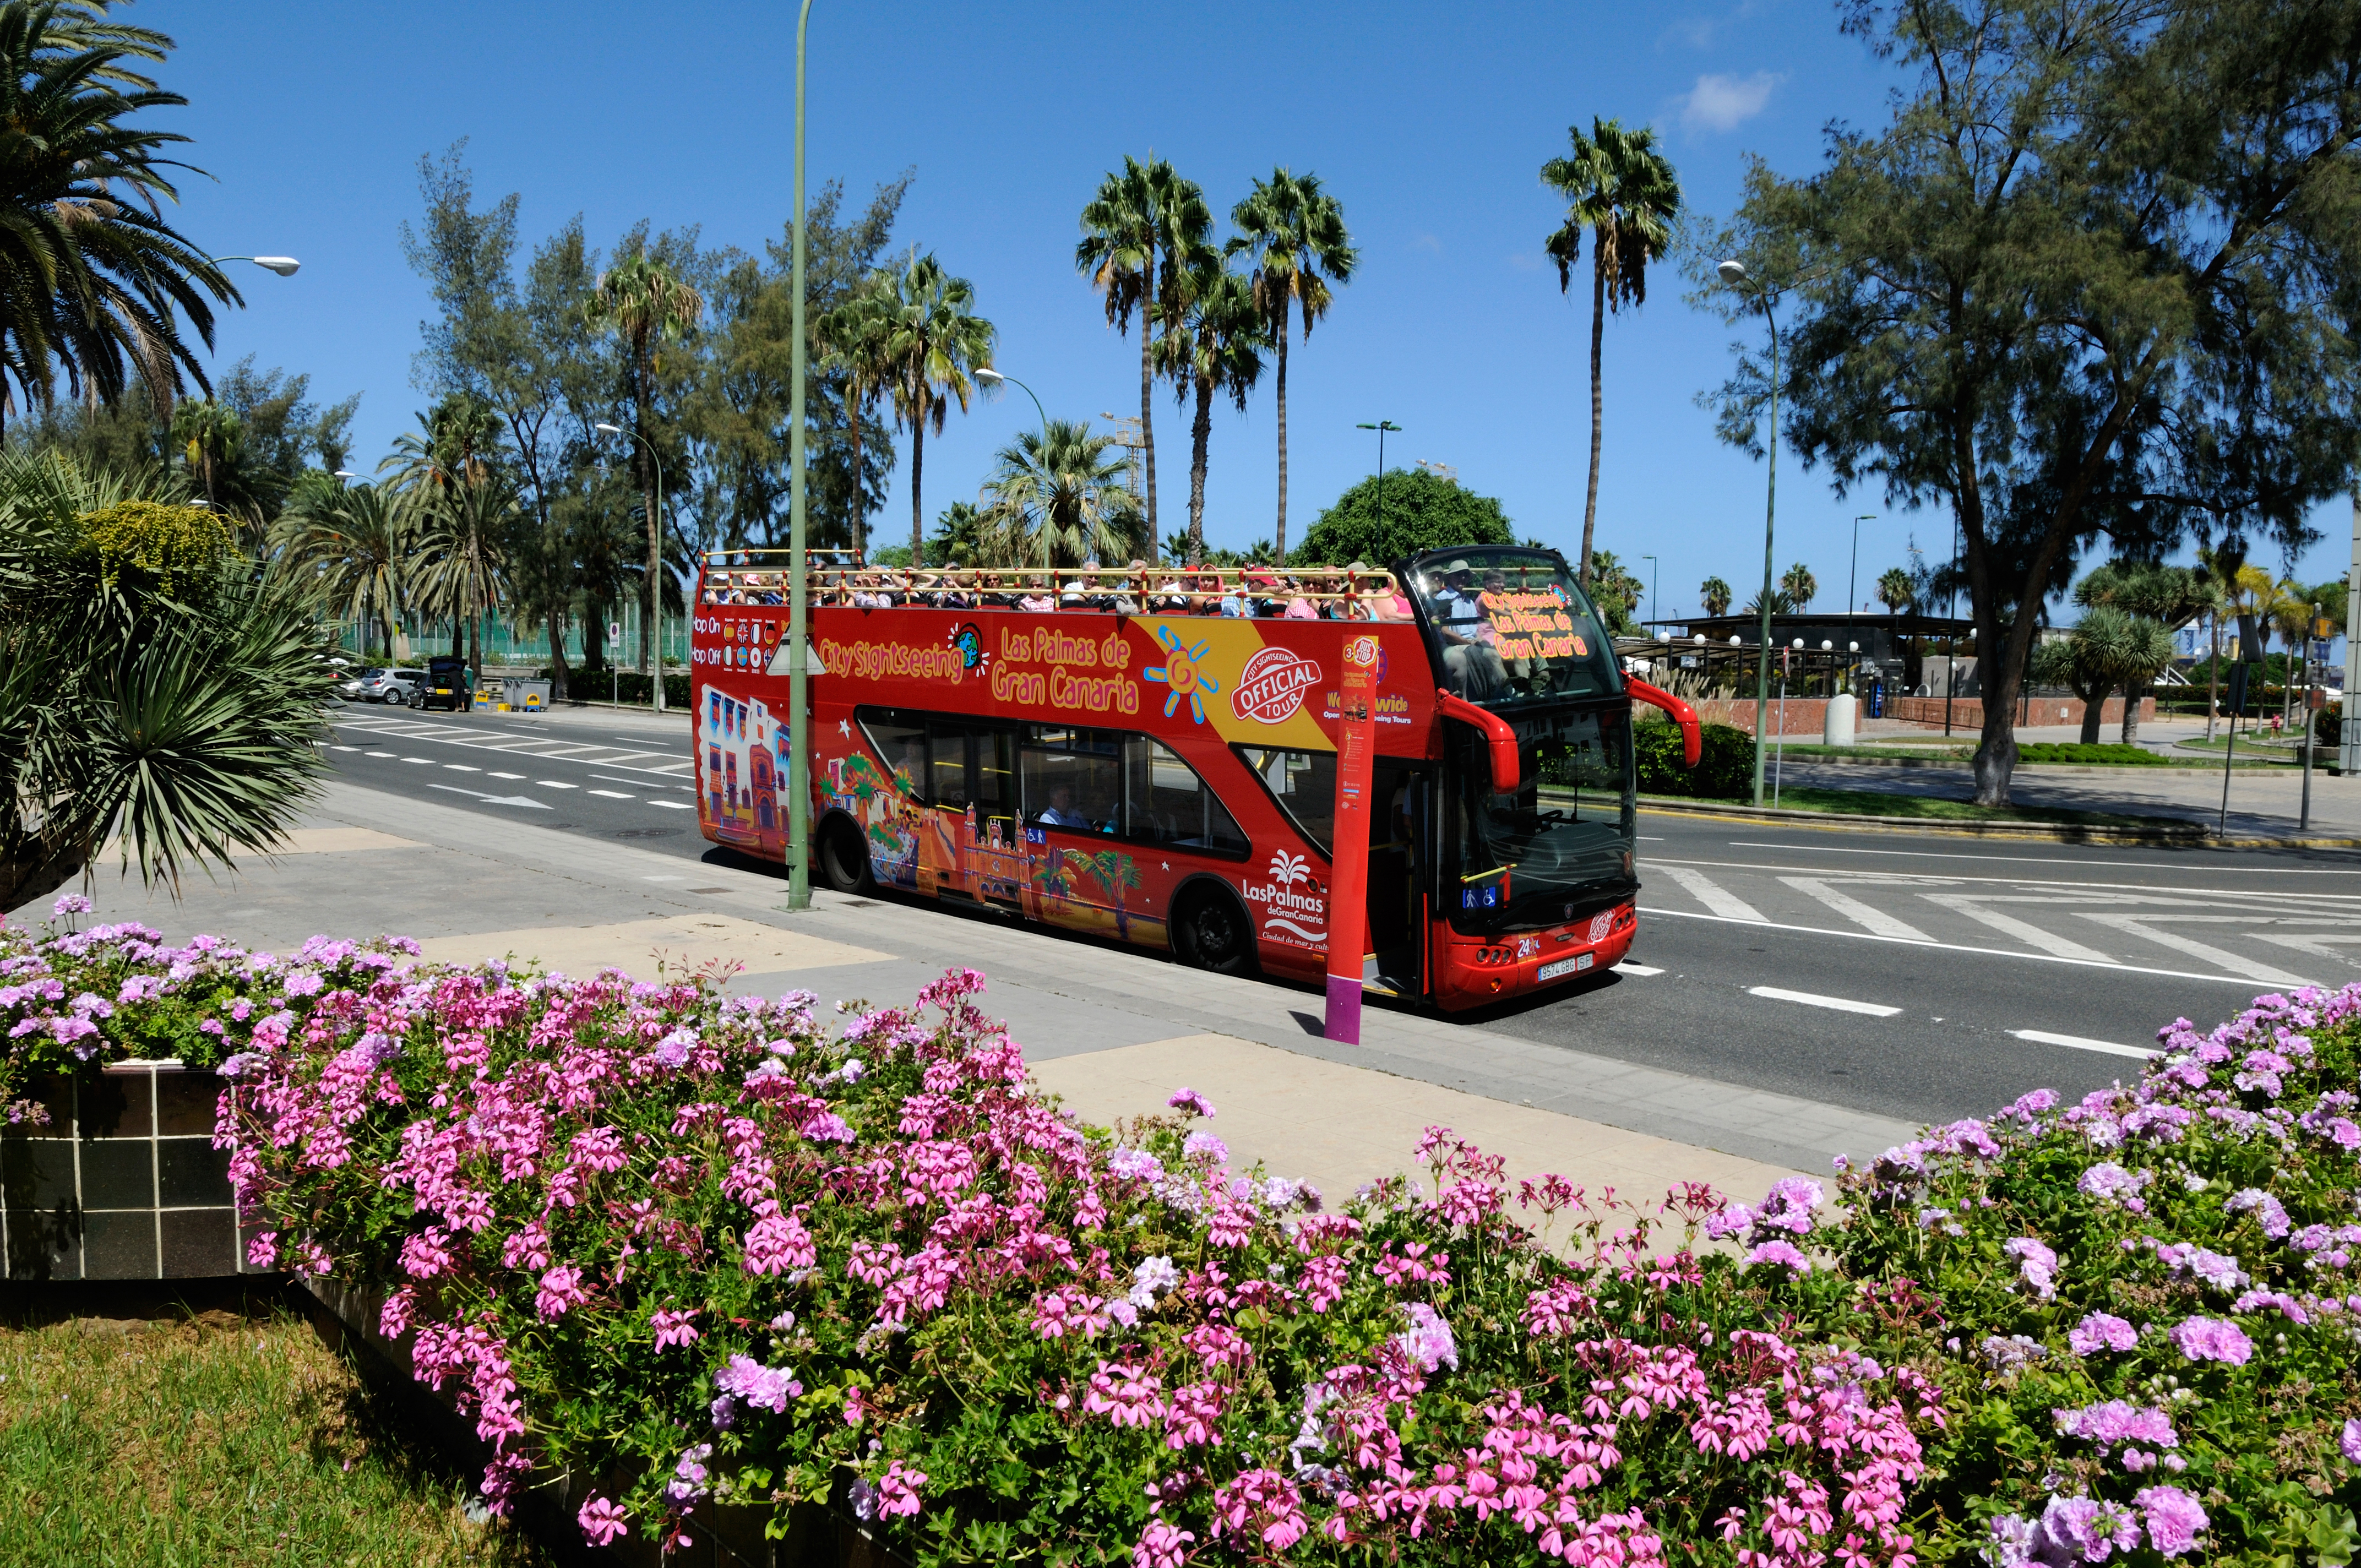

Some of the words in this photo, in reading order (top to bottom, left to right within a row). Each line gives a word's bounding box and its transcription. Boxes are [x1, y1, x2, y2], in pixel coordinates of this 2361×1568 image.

[709, 617, 720, 634] On
[1489, 612, 1516, 633] Las
[1511, 610, 1555, 632] Palmas
[1554, 610, 1573, 631] de
[708, 647, 721, 665] Off
[1002, 627, 1031, 662] Las
[1034, 627, 1097, 667] Palmas
[1101, 631, 1131, 669] de
[1346, 647, 1352, 658] 3
[1354, 649, 1371, 662] STOP
[1359, 640, 1372, 653] BUS
[1494, 633, 1536, 660] Gran
[1532, 632, 1588, 658] Canaria
[819, 638, 853, 678] City
[854, 640, 964, 685] Sightseeing
[1248, 664, 1258, 680] CITY
[1256, 653, 1293, 668] SIGHTSEEING
[992, 660, 1045, 705] Gran
[1049, 665, 1139, 715] Canaria
[1241, 664, 1316, 710] OFFICIAL
[1266, 693, 1299, 717] TOUR
[1392, 716, 1411, 724] Tours
[1243, 879, 1324, 913] LasPalmas
[1267, 904, 1323, 924] deGranCanaria
[1263, 931, 1285, 942] Ciudad
[1590, 911, 1614, 941] OFFICIAL
[1517, 938, 1530, 957] 24
[1543, 965, 1559, 978] 9574
[1562, 960, 1574, 972] GBG
